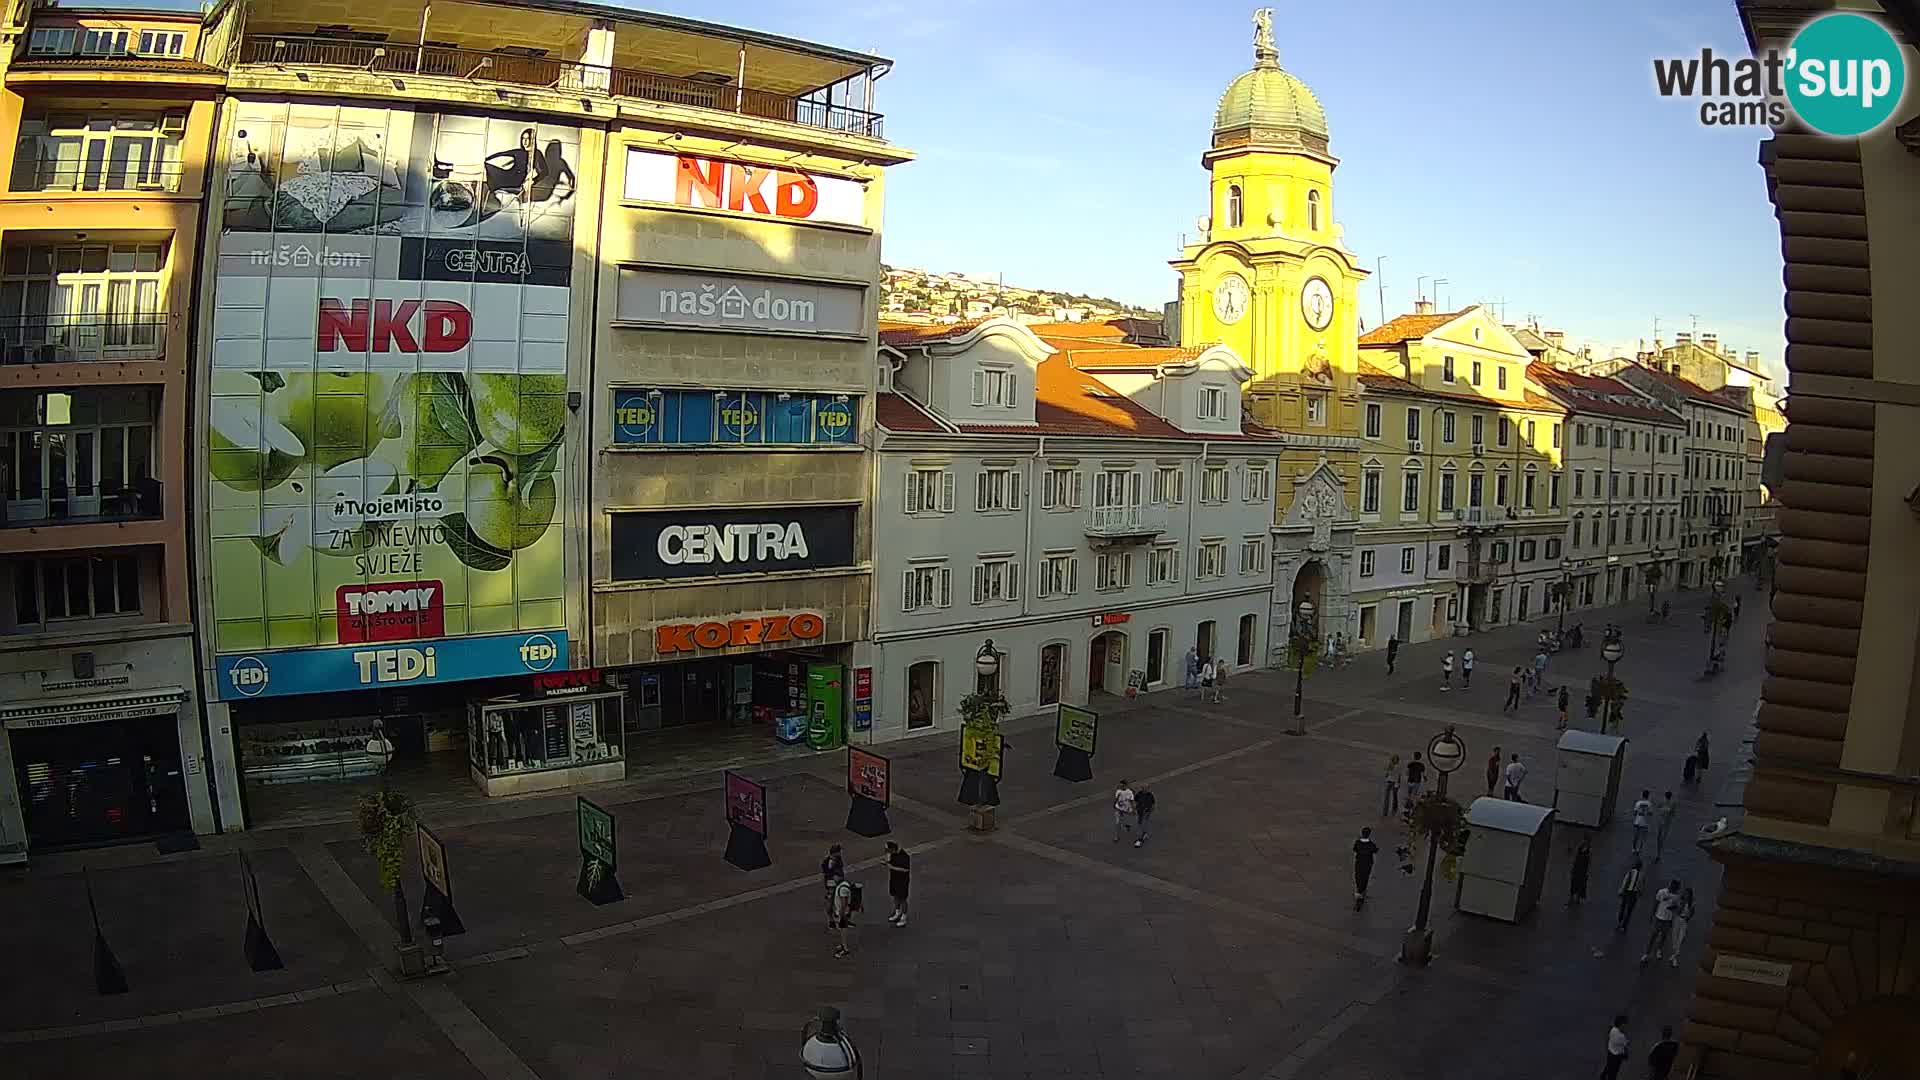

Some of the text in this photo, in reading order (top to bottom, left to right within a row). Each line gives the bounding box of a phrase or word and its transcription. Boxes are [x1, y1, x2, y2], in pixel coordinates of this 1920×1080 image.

[674, 154, 818, 218] NKD
[250, 244, 361, 268] naš dom
[444, 249, 532, 275] CENTRA
[659, 284, 815, 322] naš dom
[317, 297, 474, 353] NKD
[616, 407, 656, 426] TEDi
[721, 409, 758, 427] TEDi
[818, 410, 851, 427] TEDi
[333, 497, 443, 516] #TvojeMisto
[329, 524, 447, 550] ZA DNEVNO
[656, 520, 809, 565] CENTRA
[355, 549, 423, 576] SVJEŽE
[345, 587, 436, 616] TOMMY
[656, 613, 824, 654] KORZO
[353, 646, 436, 684] TEDi
[520, 644, 557, 662] TEDi
[229, 666, 269, 686] TEDi
